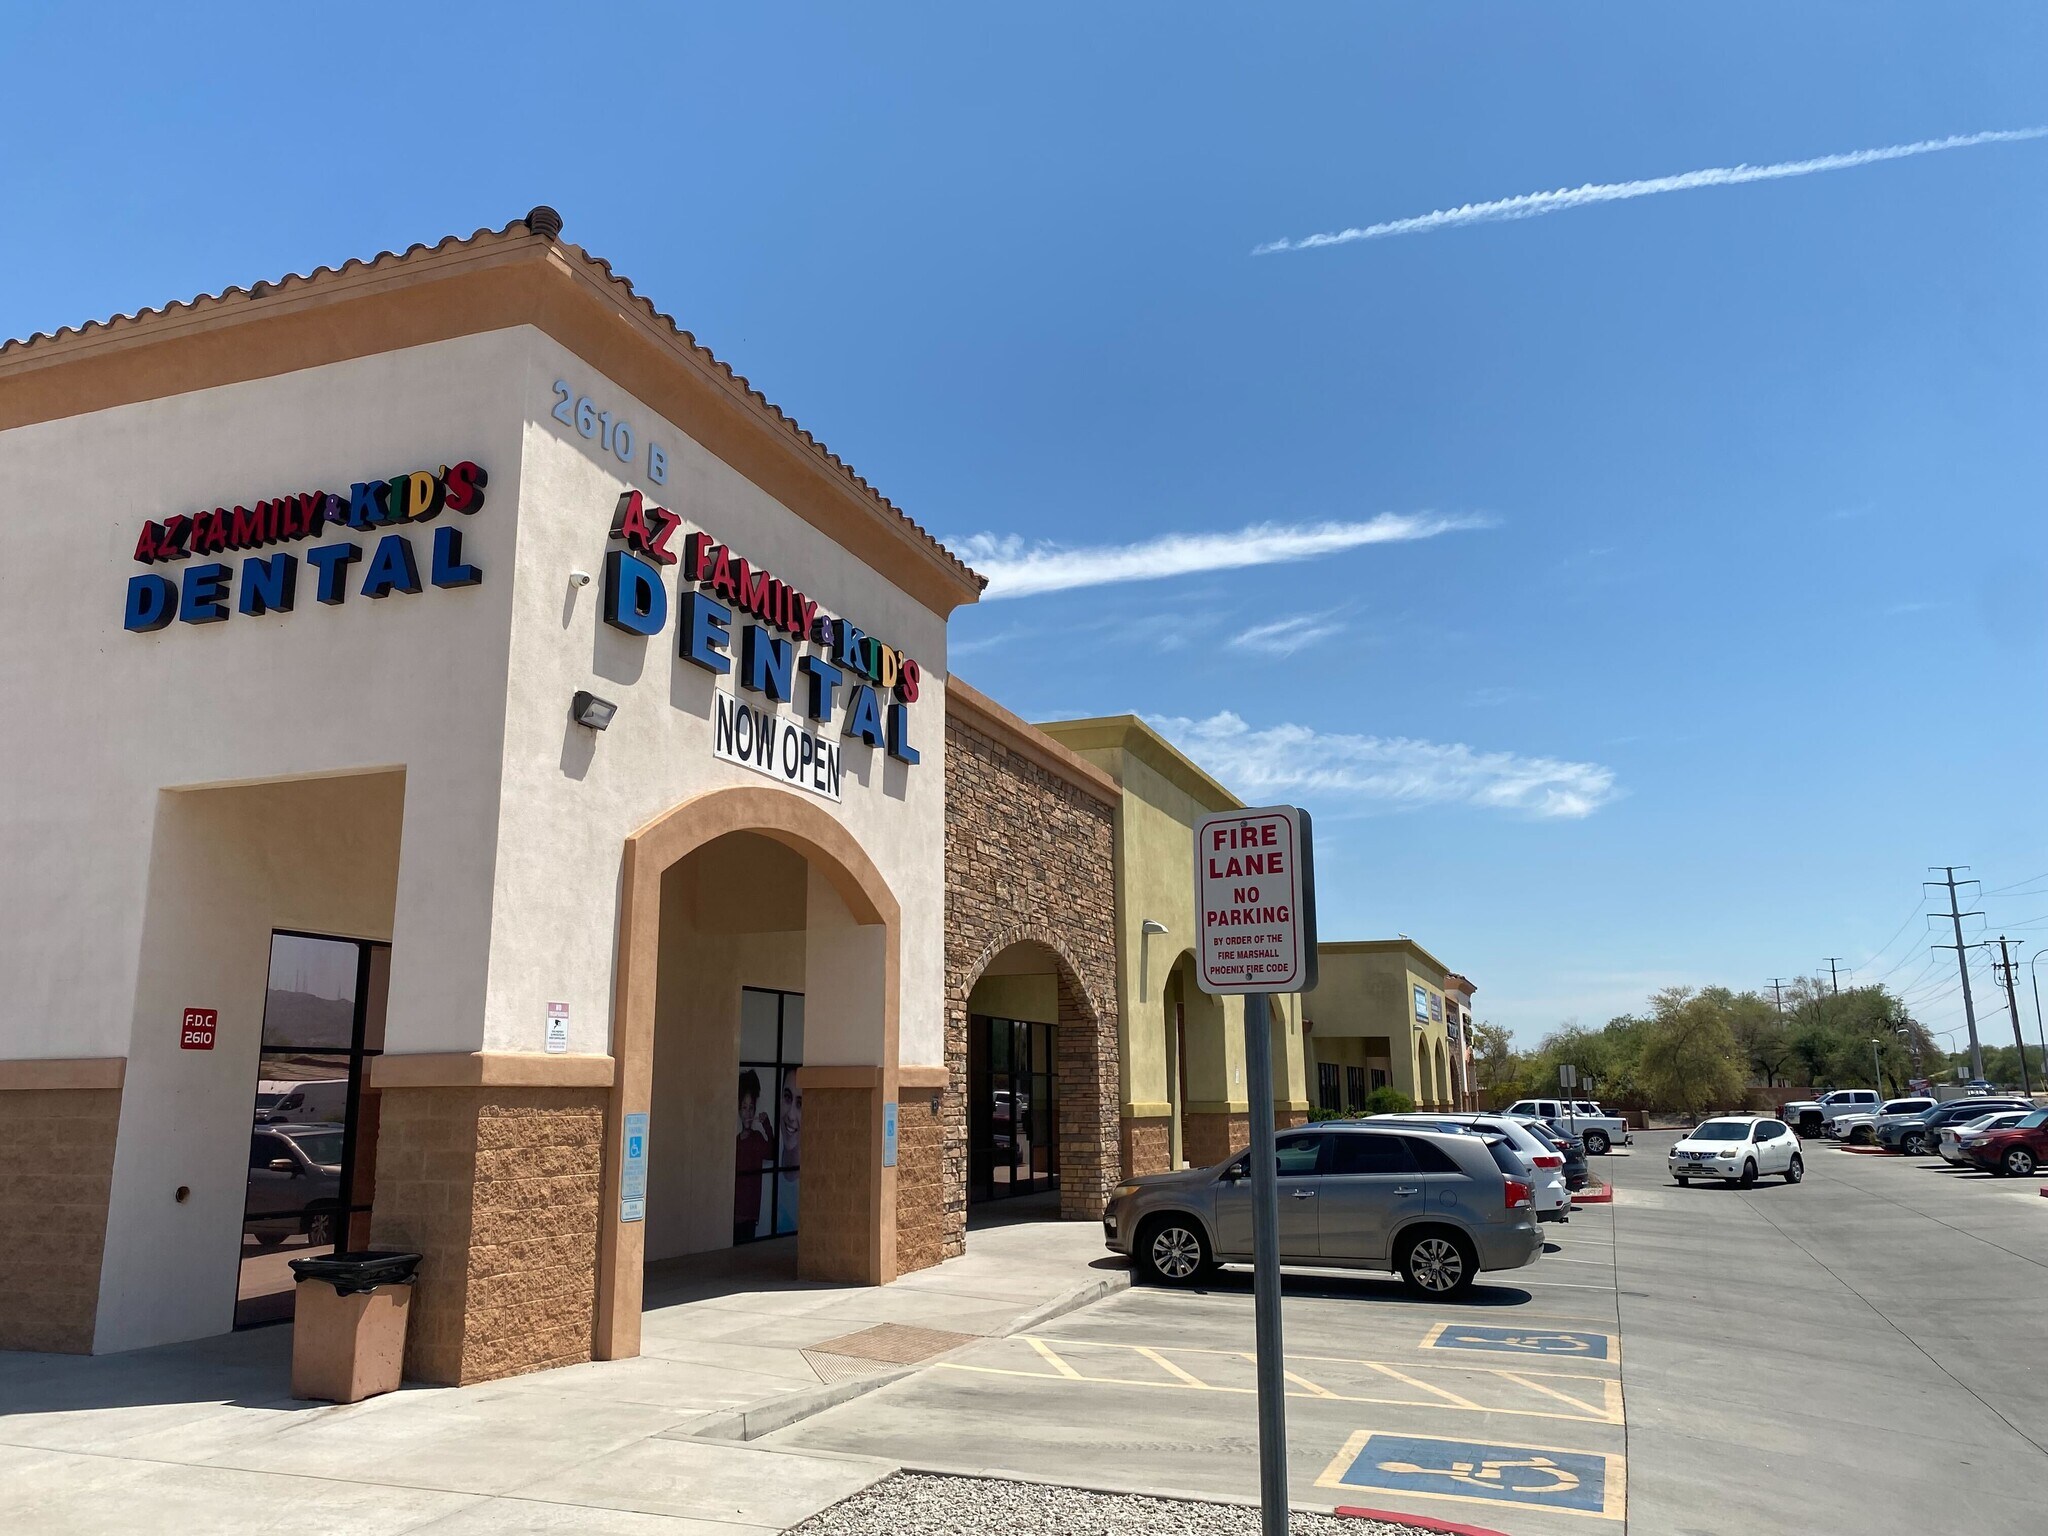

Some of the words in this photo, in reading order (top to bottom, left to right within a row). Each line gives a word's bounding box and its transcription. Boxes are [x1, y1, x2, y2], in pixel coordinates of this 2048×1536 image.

[552, 380, 635, 464] 2610
[648, 442, 669, 485] B
[134, 515, 191, 564] AZ
[190, 491, 326, 556] FAMILY
[324, 494, 350, 526] &
[346, 461, 488, 531] KID'S
[124, 526, 482, 633] DENTAL
[610, 490, 681, 565] AZ
[685, 532, 818, 642] FAMILY
[812, 615, 835, 647] &
[831, 618, 920, 703] KID'S
[604, 550, 920, 765] DENTAL
[717, 692, 776, 770] NOW
[783, 726, 840, 798] OPEN
[1213, 824, 1277, 851] FIRE
[1209, 852, 1284, 879] LANE
[1234, 886, 1260, 904] NO
[1207, 905, 1289, 927] PARKING
[1213, 937, 1223, 946] BY
[1225, 935, 1252, 945] ORDER
[1254, 934, 1265, 944] OF
[1267, 934, 1283, 943] THE
[1218, 951, 1235, 960] FIRE
[1237, 949, 1280, 959] MARSHALL
[1210, 965, 1245, 975] PHOENIX
[1246, 964, 1264, 974] FIRE
[1266, 963, 1289, 973] CODE
[185, 1014, 214, 1027] F.D.C.
[184, 1032, 212, 1044] 2610
